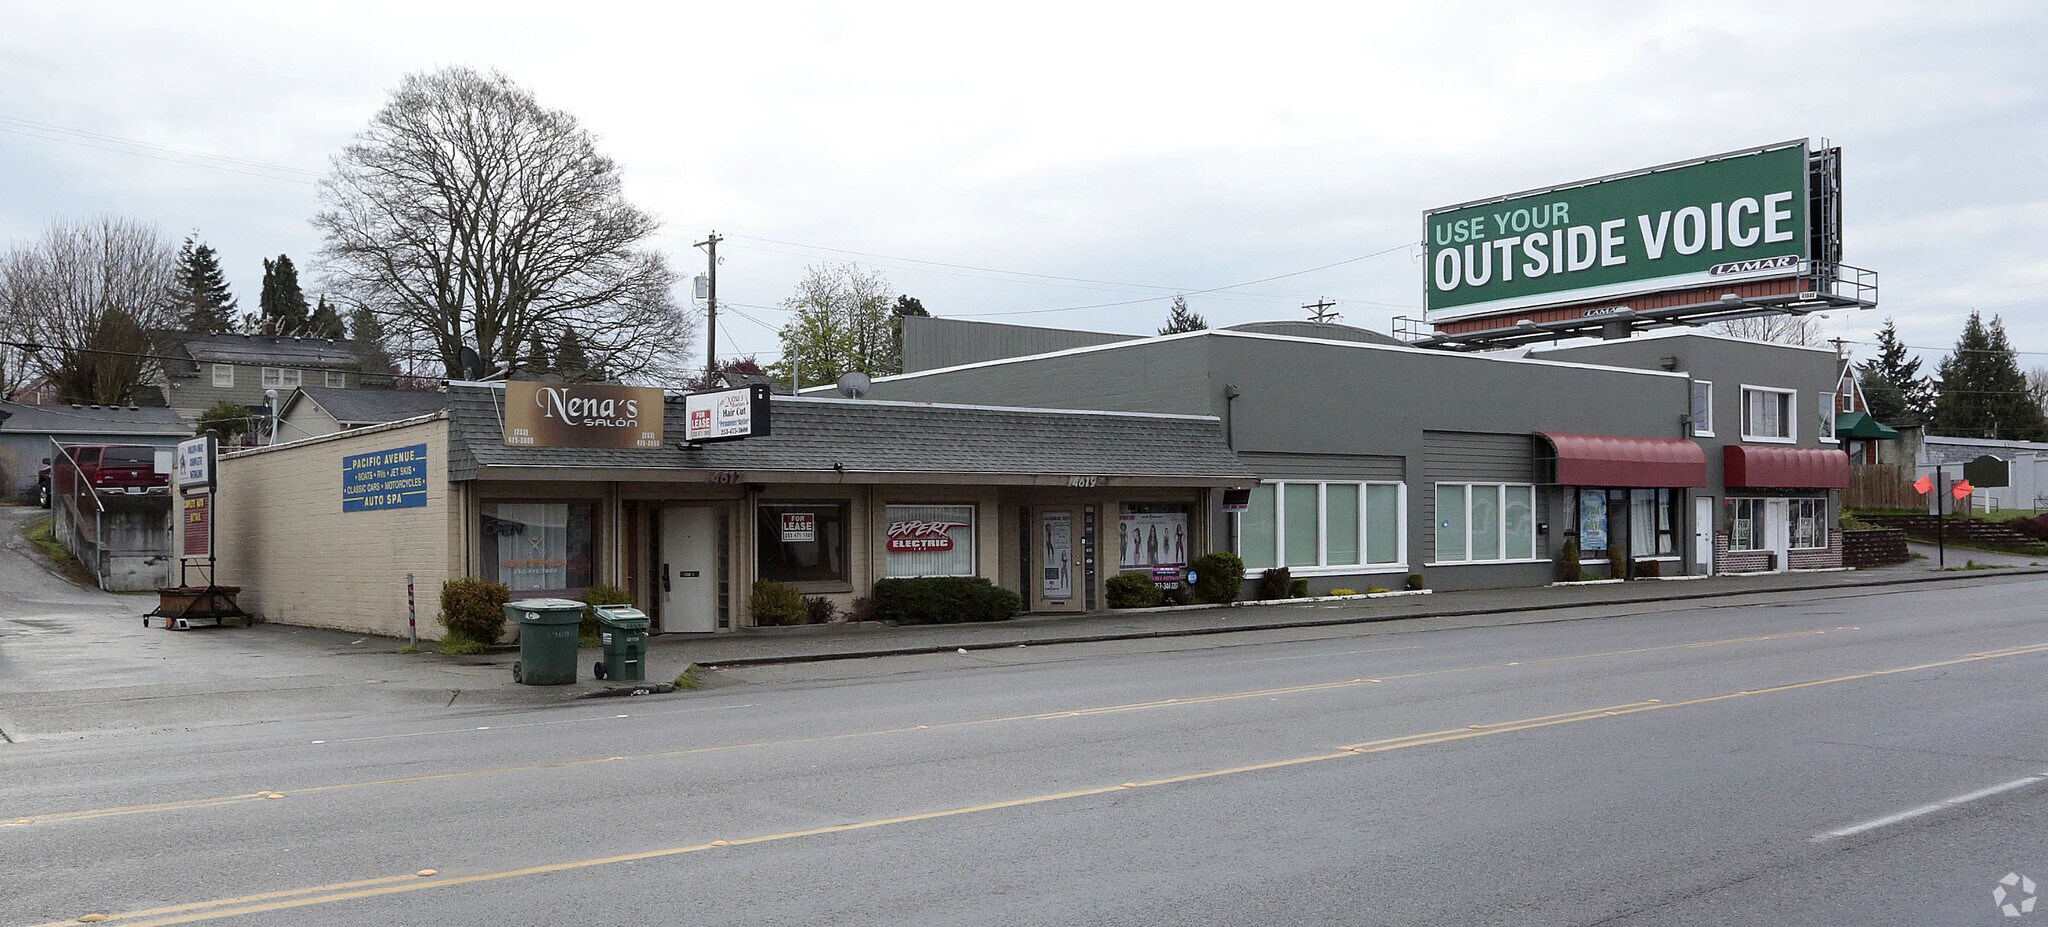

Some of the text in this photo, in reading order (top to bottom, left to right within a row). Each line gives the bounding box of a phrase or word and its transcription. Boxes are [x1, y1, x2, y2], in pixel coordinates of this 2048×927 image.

[1436, 201, 1570, 246] USE YOUR
[1435, 190, 1794, 292] OUTSIDE VOICE
[1716, 257, 1790, 275] LAMAR
[535, 387, 639, 426] Nena's
[692, 418, 710, 428] LEASE
[695, 411, 706, 419] FOR
[352, 450, 415, 469] PACIFIC AVENUE
[357, 472, 373, 481] BOATS
[390, 467, 399, 477] JET
[400, 466, 412, 475] SKIS
[347, 478, 422, 494] CLASSIC CARS MOTORCYCLES
[364, 494, 402, 506] AUTO SPA
[783, 522, 812, 530] LEASE
[887, 520, 968, 539] EXPERT
[892, 540, 949, 548] ELECTRIC
